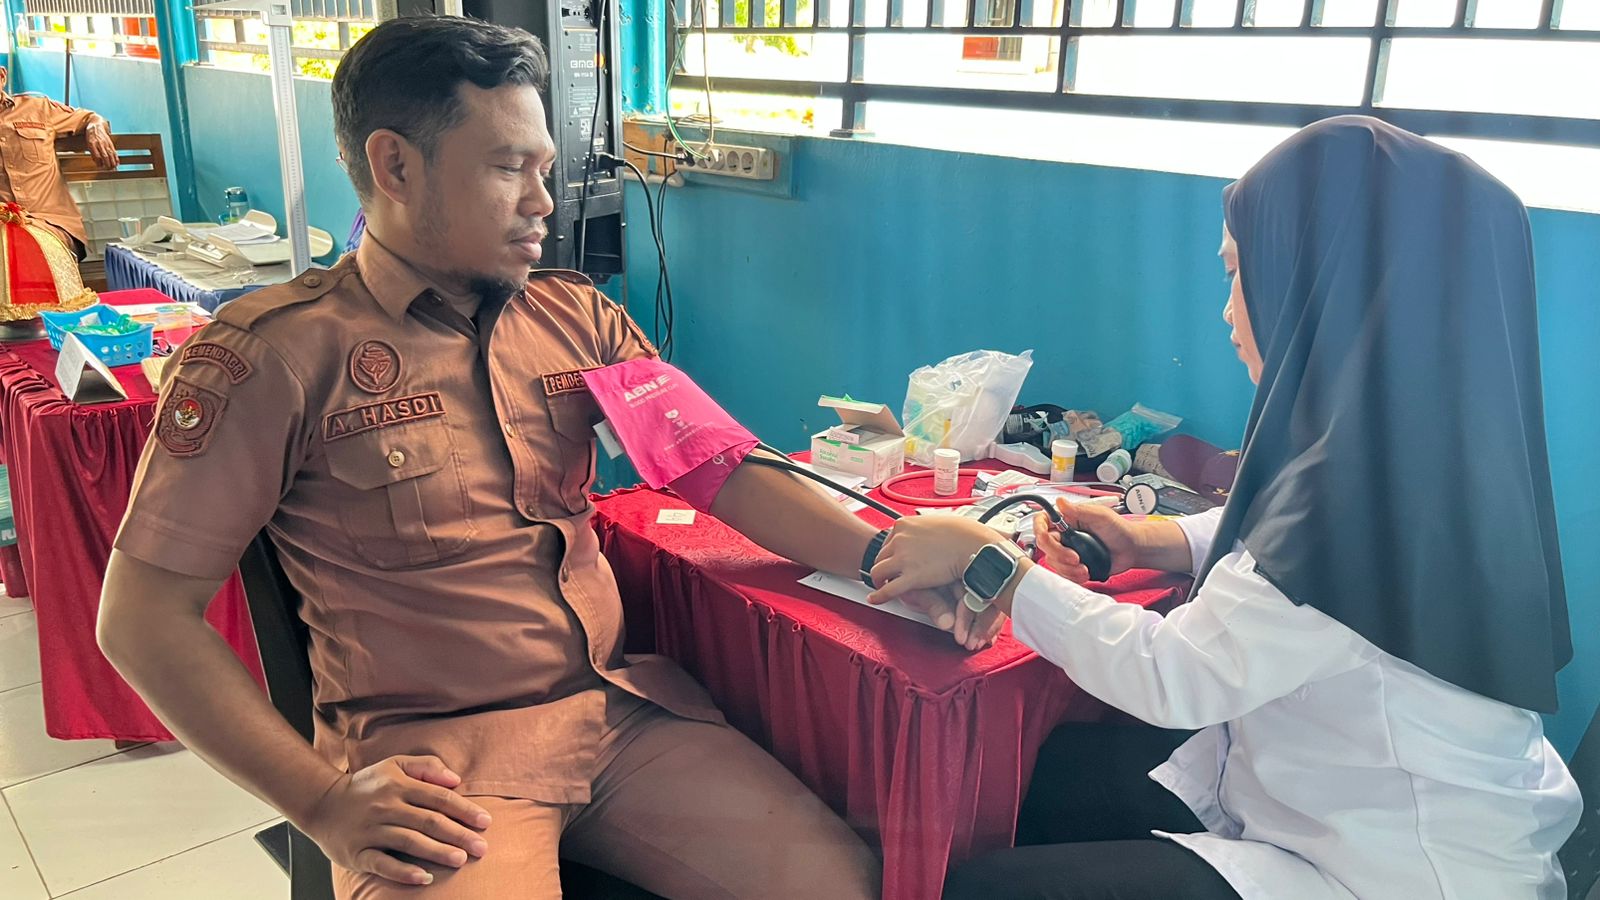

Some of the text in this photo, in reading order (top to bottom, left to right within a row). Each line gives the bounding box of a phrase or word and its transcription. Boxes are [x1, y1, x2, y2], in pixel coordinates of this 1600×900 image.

[185, 342, 248, 377] KEMENDAGRI
[332, 395, 437, 436] A. HASDI
